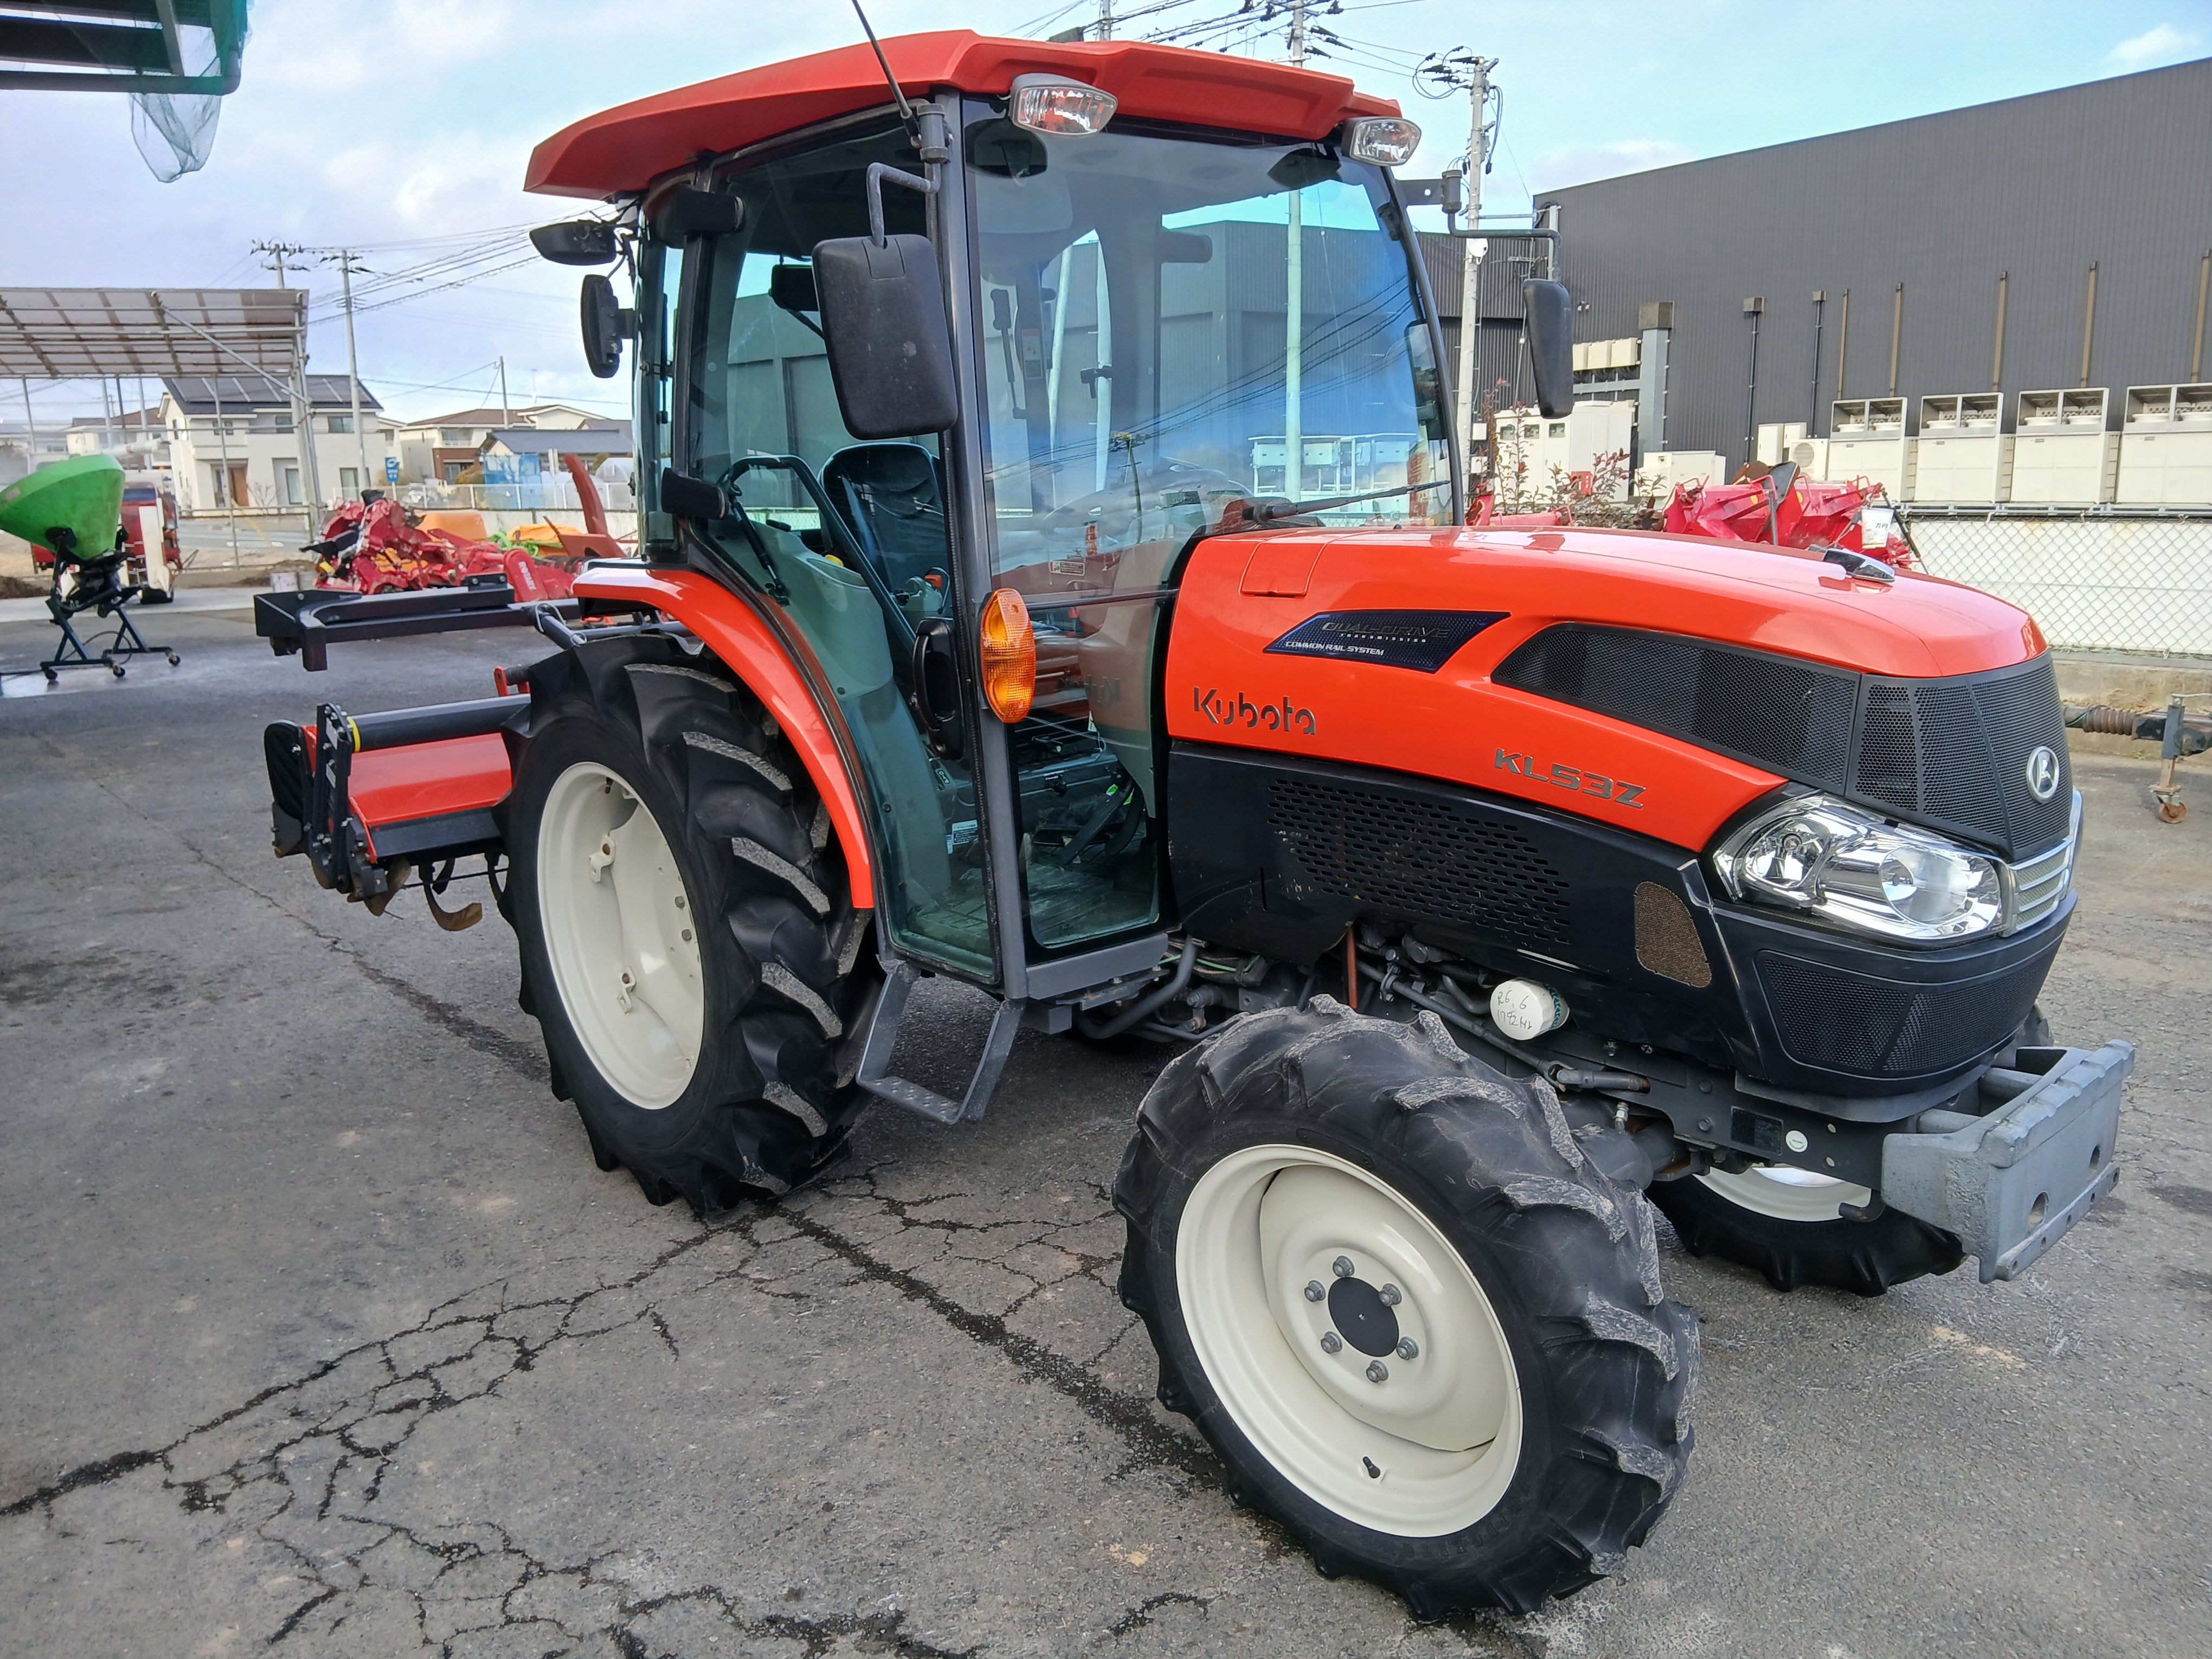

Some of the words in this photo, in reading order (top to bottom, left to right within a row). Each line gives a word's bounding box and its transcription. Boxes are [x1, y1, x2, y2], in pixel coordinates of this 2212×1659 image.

[1285, 641, 1324, 650] COMMON
[1325, 644, 1346, 652] RAIL
[1347, 645, 1385, 656] SYSTEM
[1194, 686, 1316, 736] Kubota
[1494, 747, 1647, 809] KL53Z
